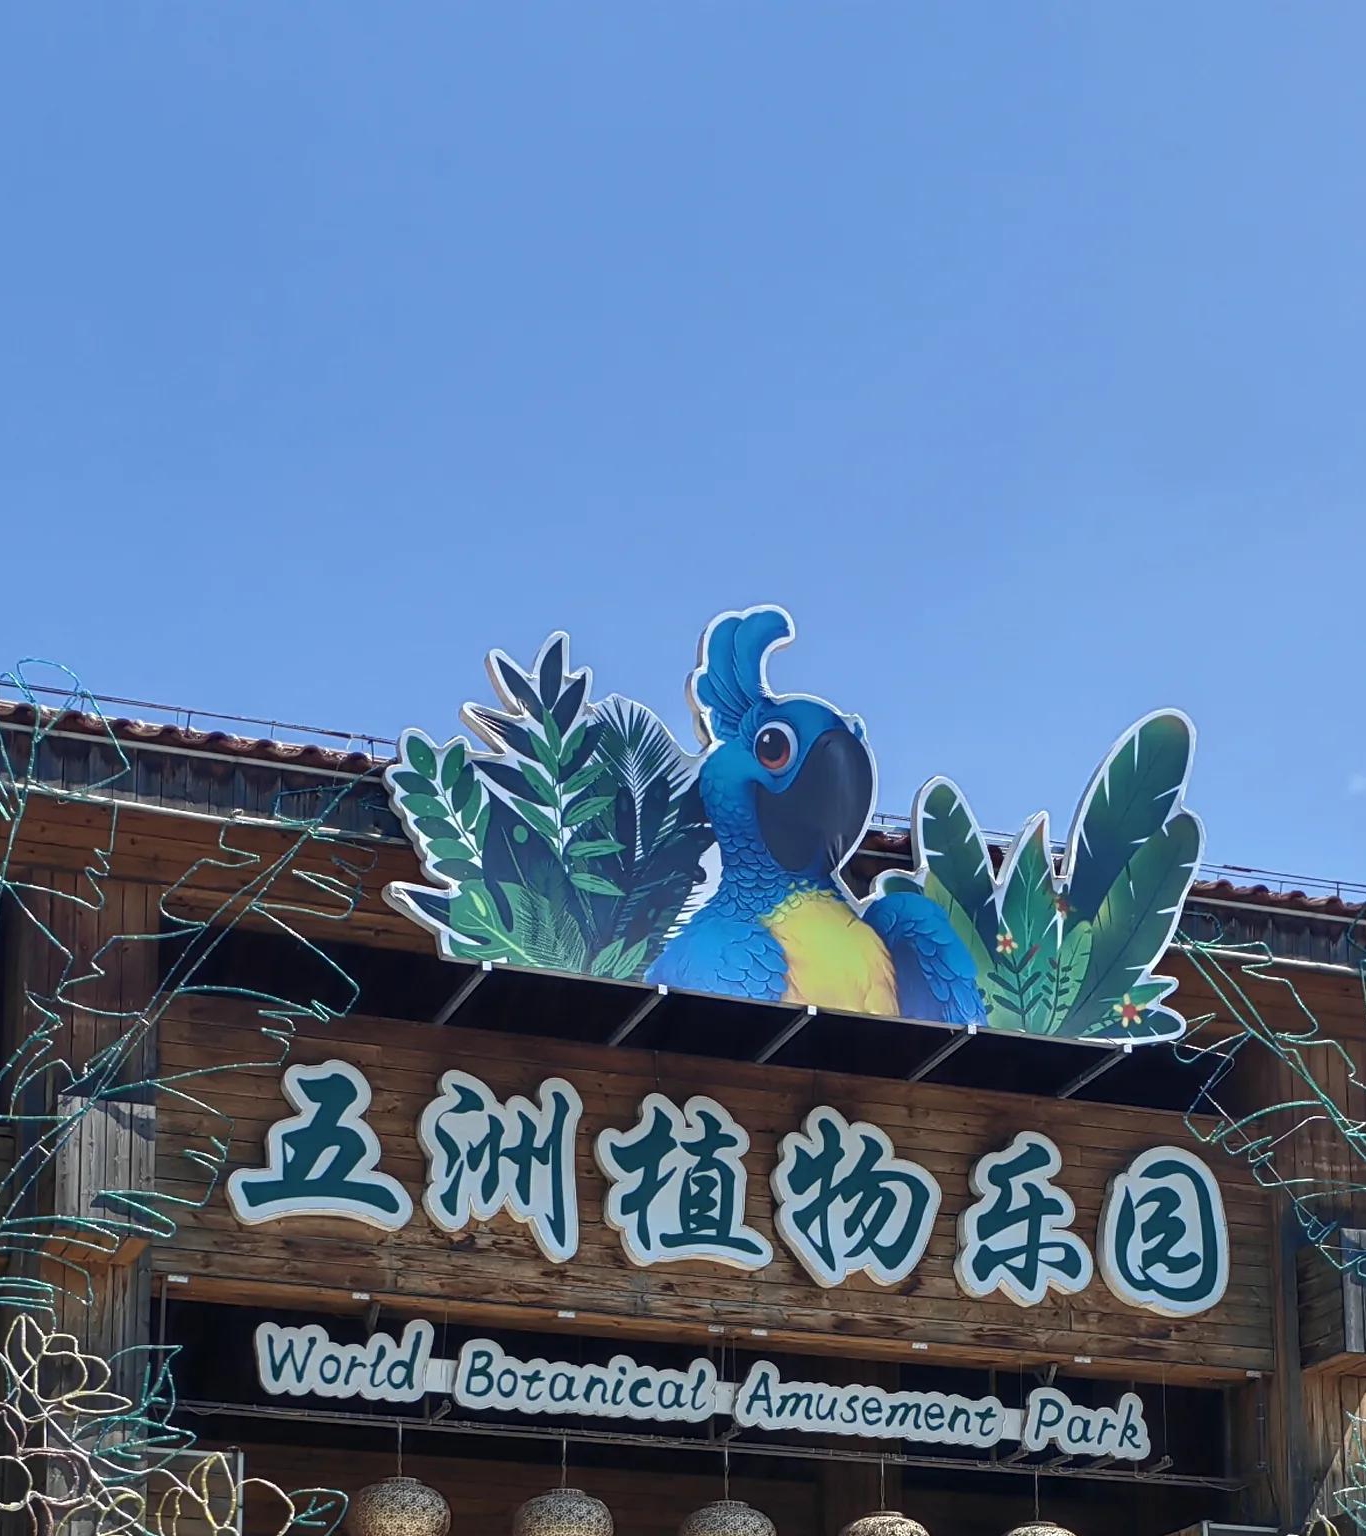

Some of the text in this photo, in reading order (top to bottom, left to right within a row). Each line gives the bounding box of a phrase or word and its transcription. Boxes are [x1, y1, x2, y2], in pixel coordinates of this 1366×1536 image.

[239, 1071, 1222, 1305] 五洲植物乐园
[265, 1328, 1147, 1451] World Botanical Amusement Park
